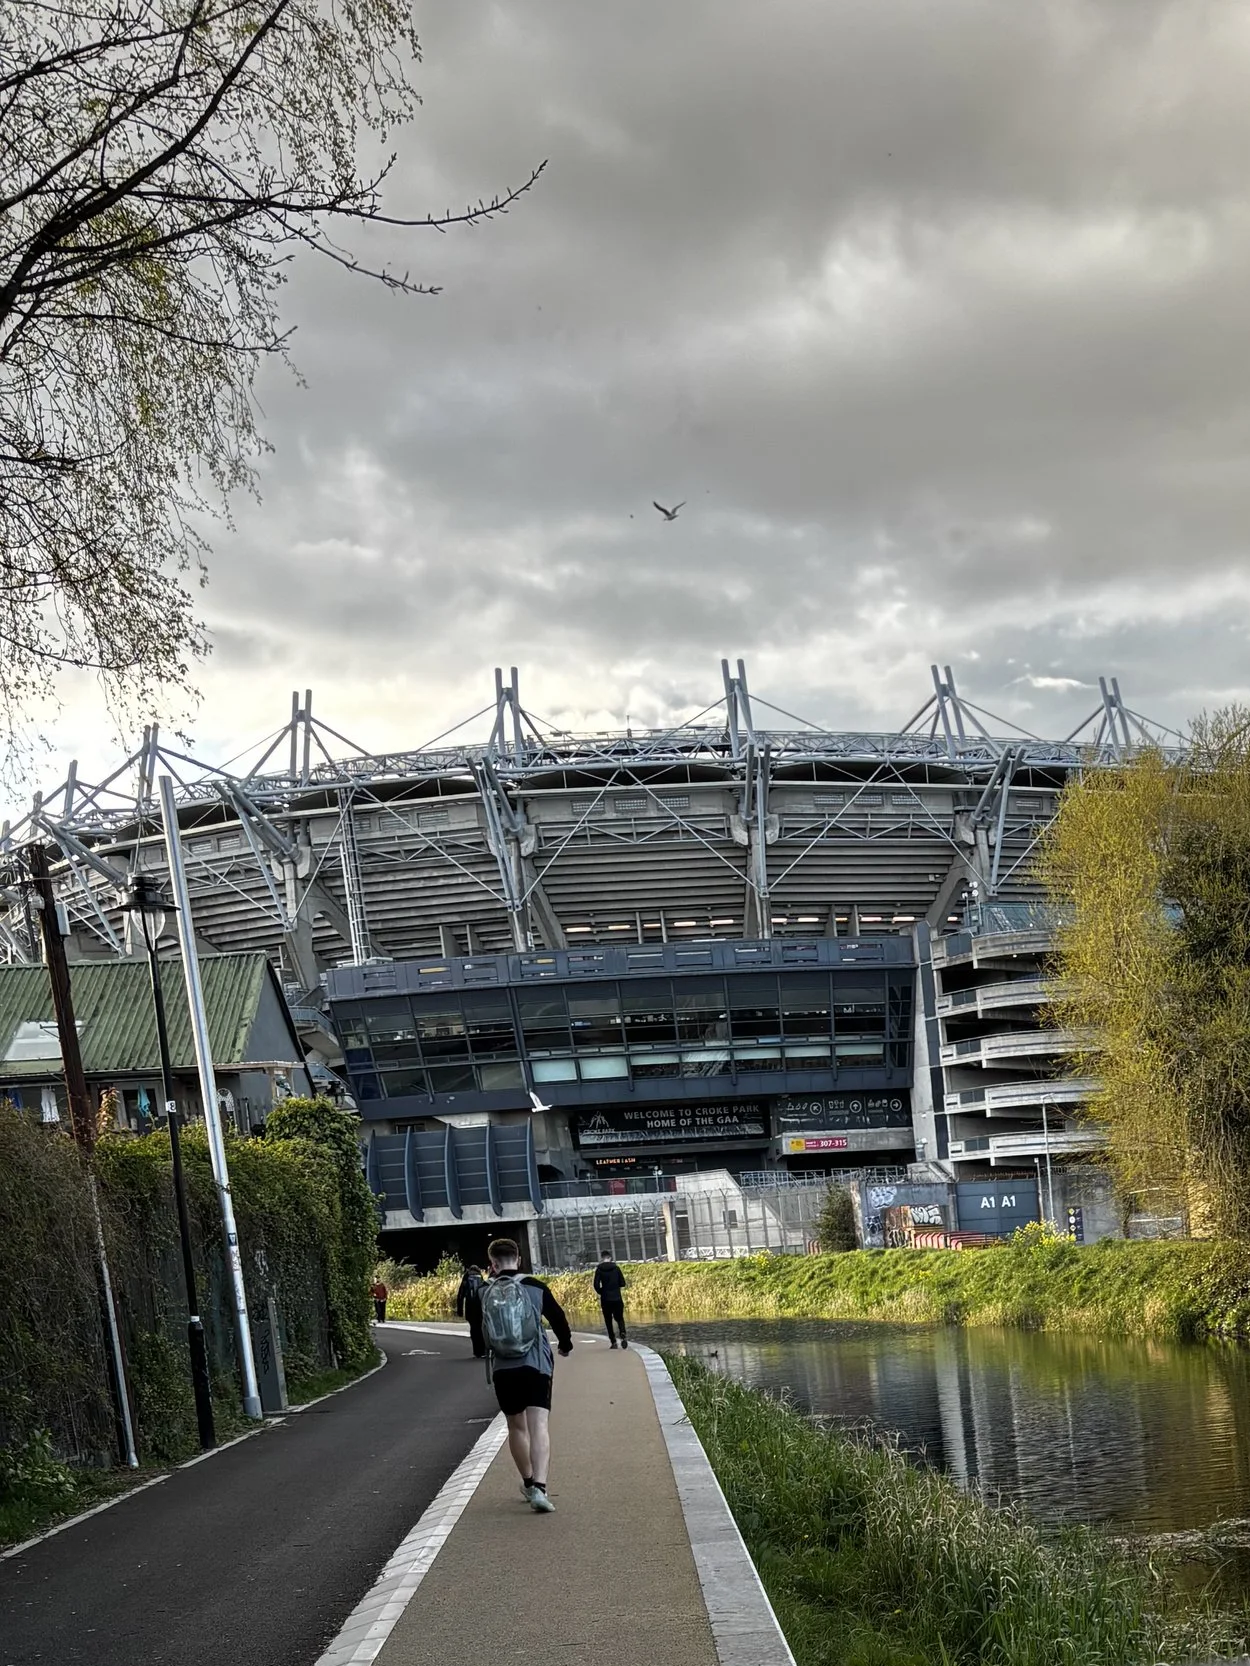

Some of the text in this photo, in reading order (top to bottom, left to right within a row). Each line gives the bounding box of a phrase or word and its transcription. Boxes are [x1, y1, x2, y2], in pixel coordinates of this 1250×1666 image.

[624, 1105, 760, 1120] WELCOME TO CROKE PARK
[647, 1115, 740, 1129] HOME OF THE GAA
[820, 1138, 847, 1147] 307-315
[980, 1196, 1016, 1209] A1 A1
